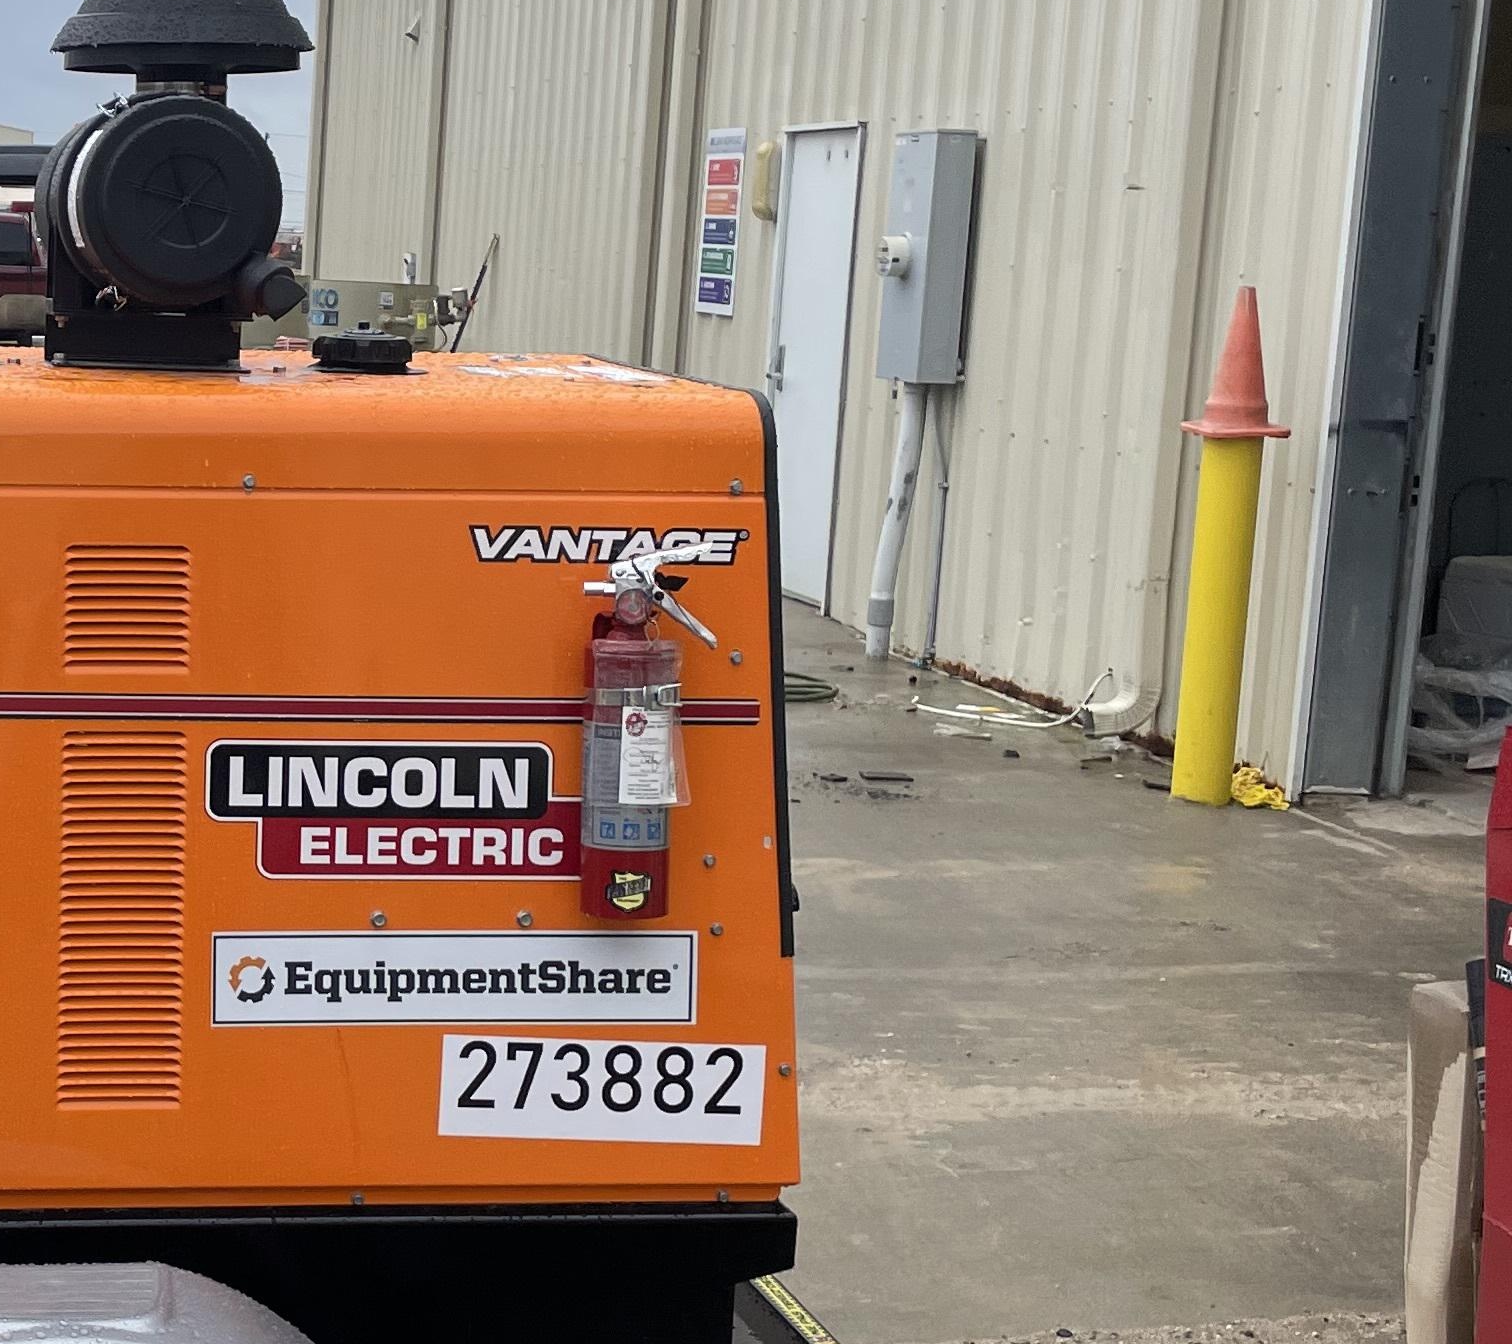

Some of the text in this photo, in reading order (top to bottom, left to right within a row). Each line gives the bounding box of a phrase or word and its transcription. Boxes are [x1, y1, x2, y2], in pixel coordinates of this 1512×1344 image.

[472, 527, 738, 563] VANTAGE
[228, 755, 530, 809] LINCOLN
[299, 826, 565, 866] ELECTRIC
[284, 959, 672, 1003] EquipmentShare
[457, 1040, 745, 1116] 273882
